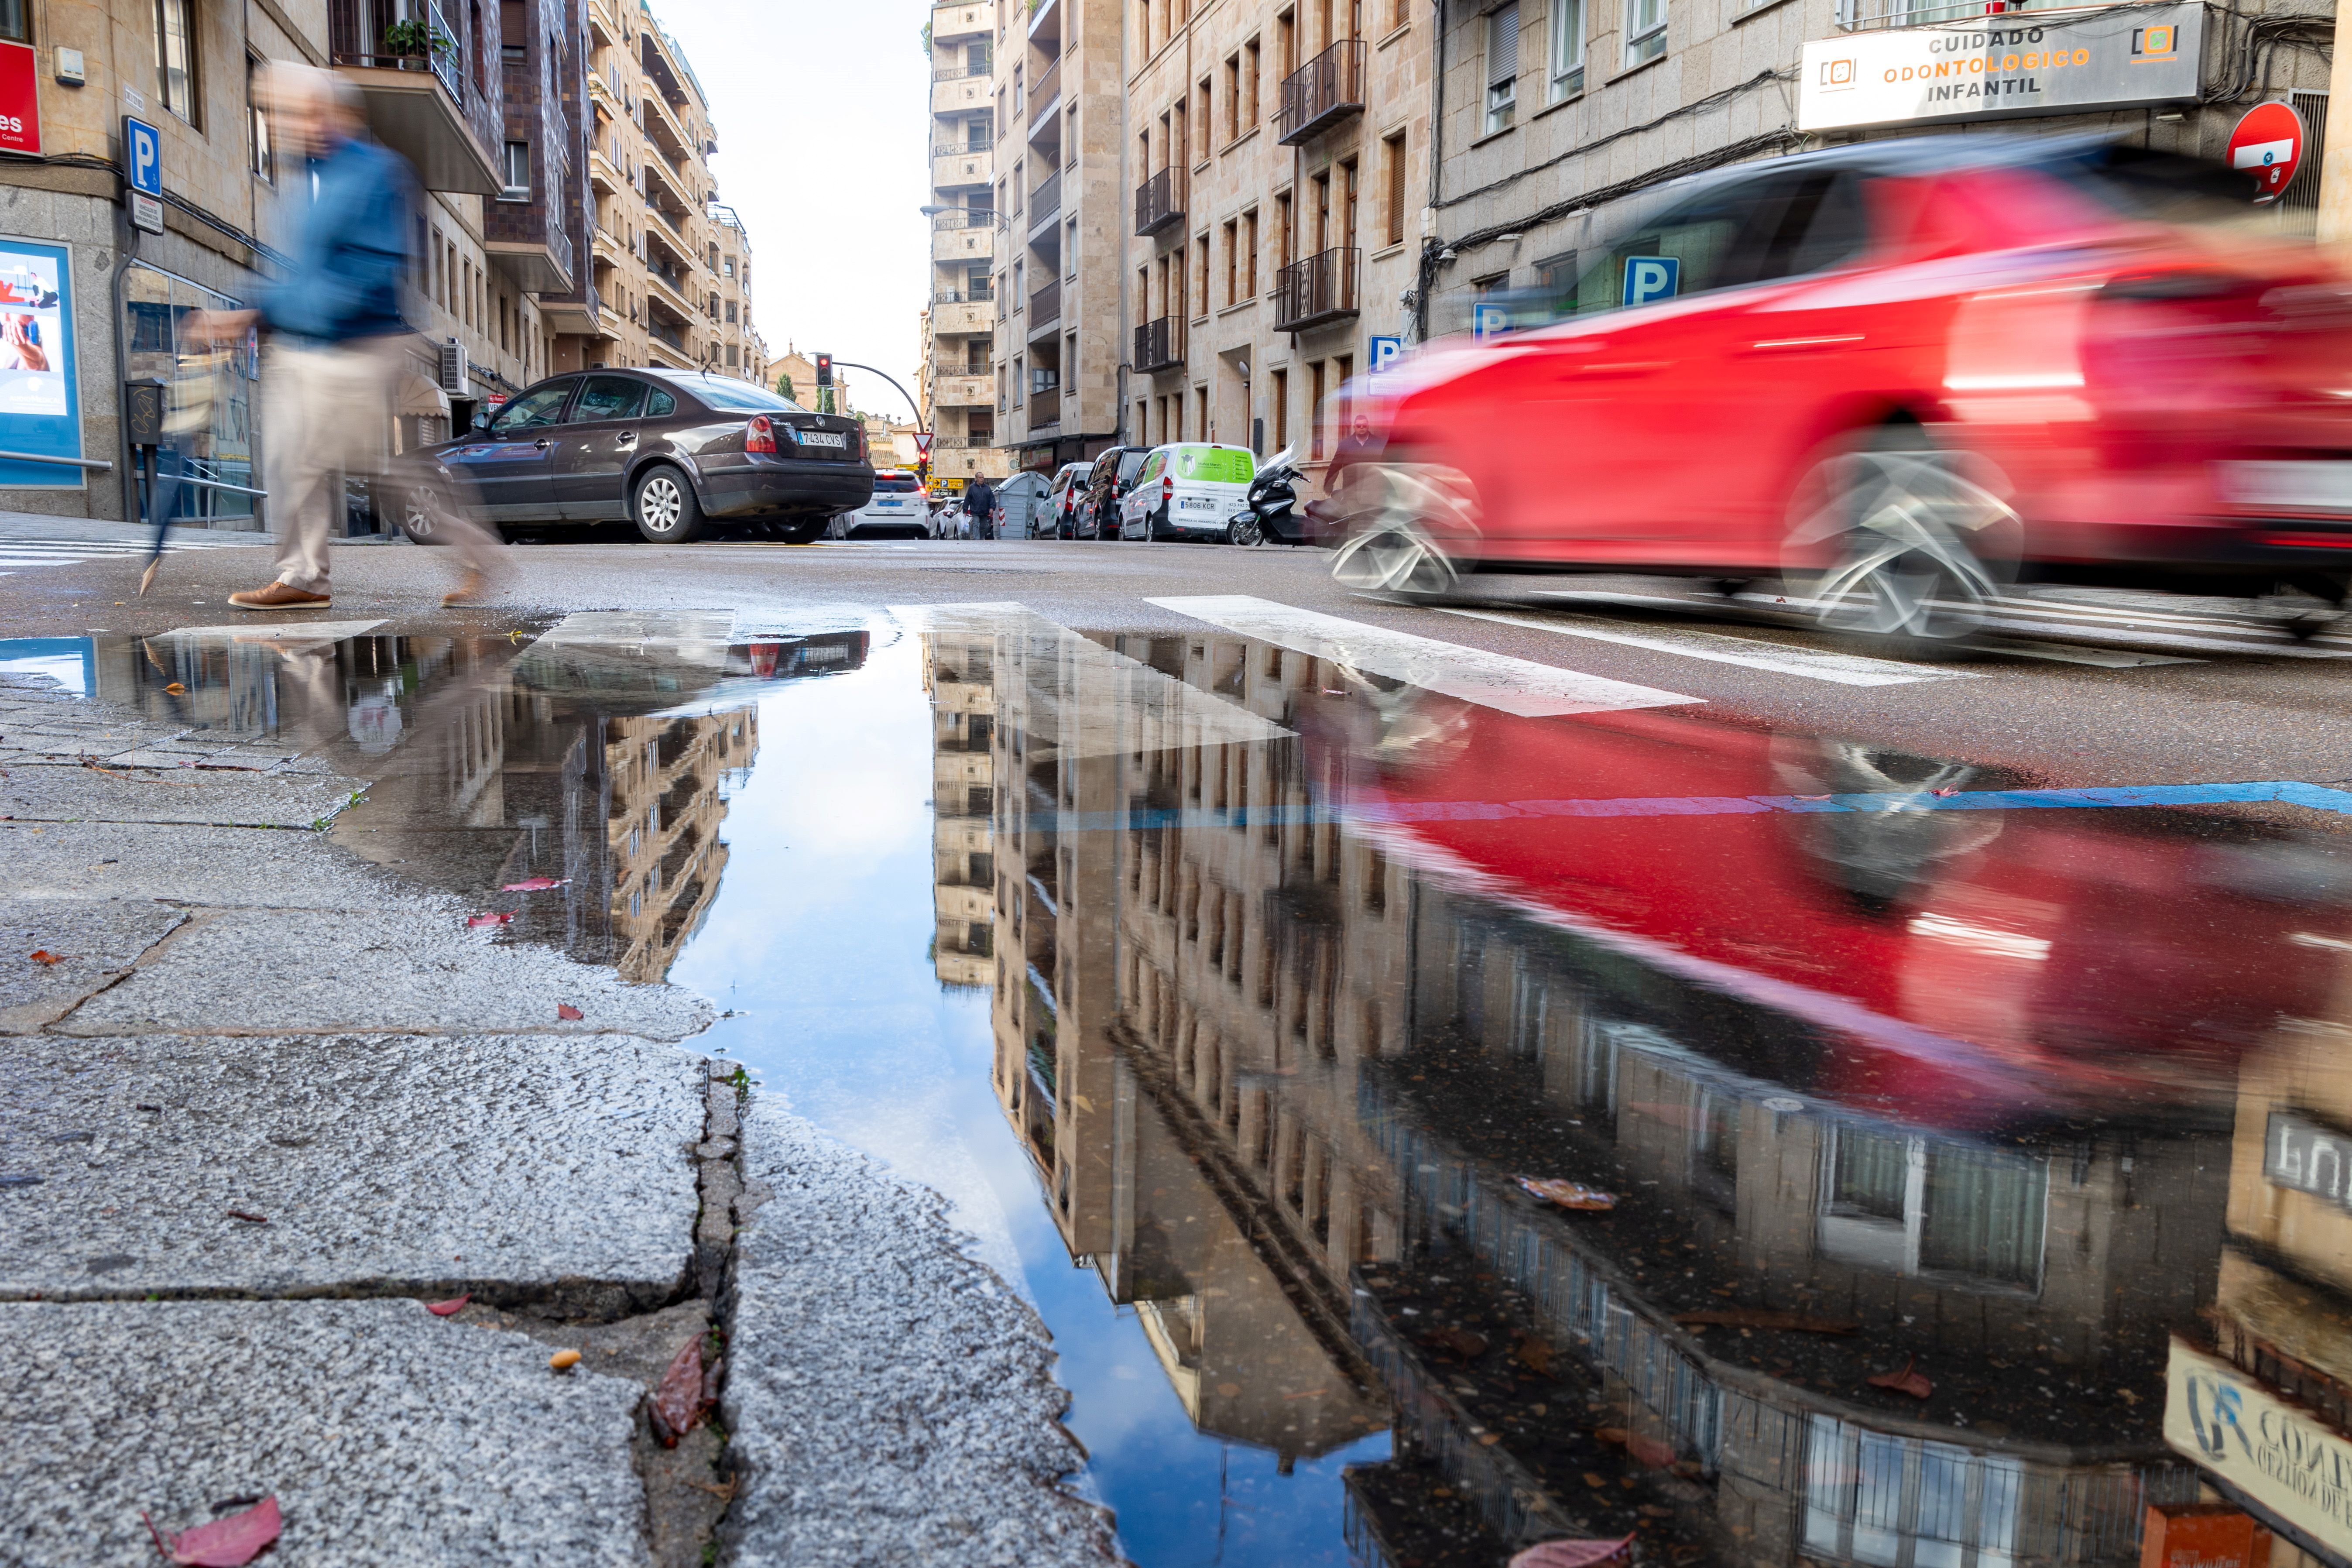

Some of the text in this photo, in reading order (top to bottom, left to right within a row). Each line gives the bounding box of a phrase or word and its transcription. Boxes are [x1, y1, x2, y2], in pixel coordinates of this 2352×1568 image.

[1929, 28, 2043, 54] CUIDADO
[1884, 48, 2090, 82] ODONTOLOGICO
[1928, 78, 2041, 102] INFANTIL
[2, 134, 23, 143] Centre
[135, 129, 154, 181] P
[1633, 262, 1668, 306] P
[1482, 309, 1507, 342] P
[1377, 340, 1400, 371] P
[804, 433, 840, 445] 7434 CVS
